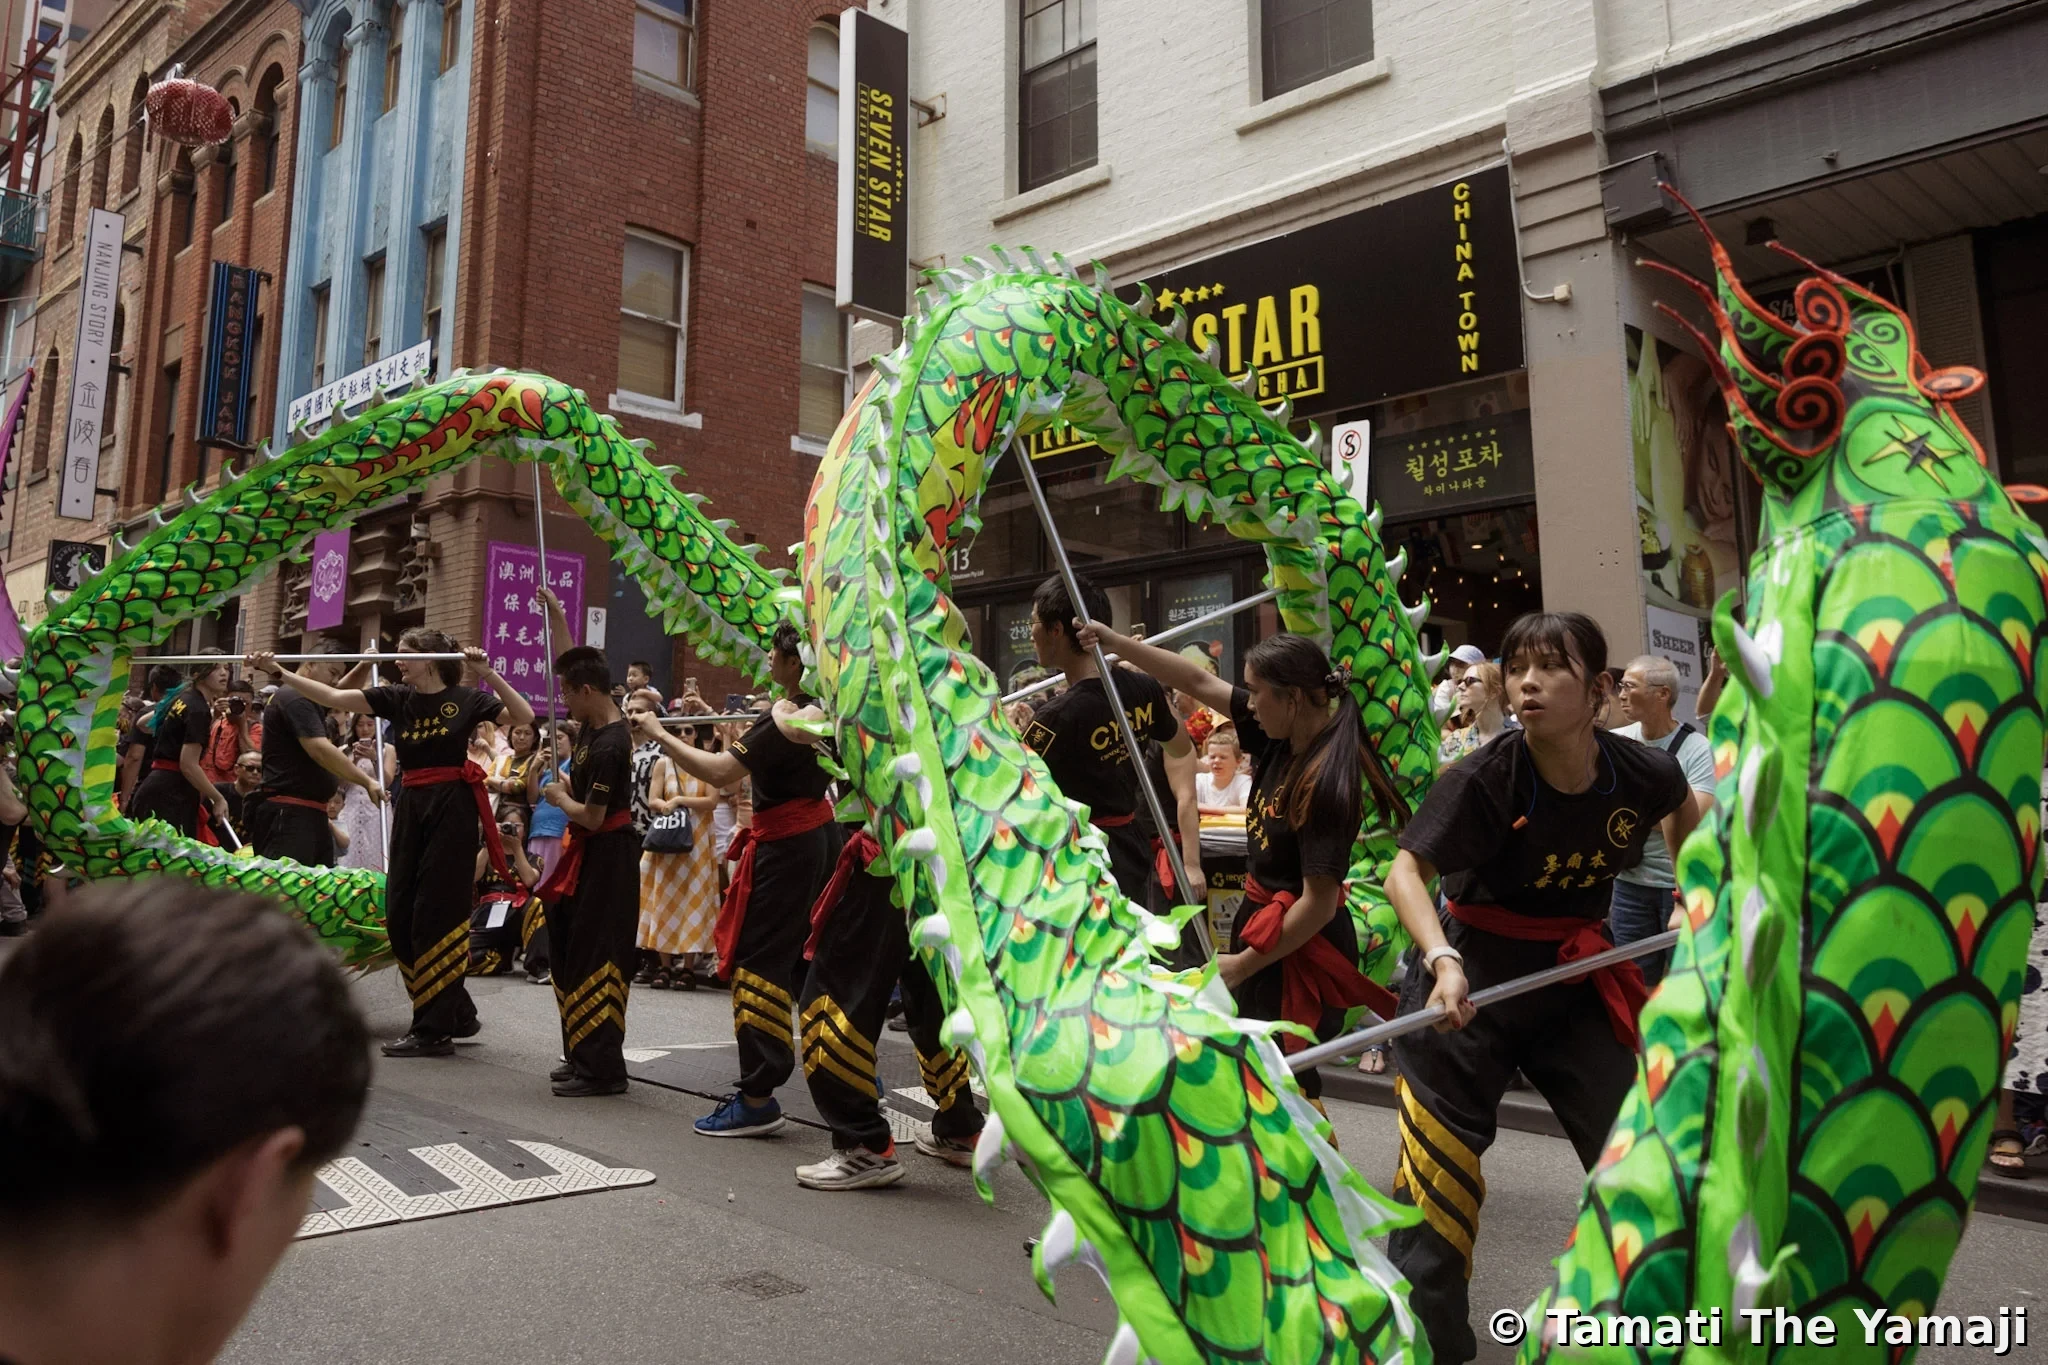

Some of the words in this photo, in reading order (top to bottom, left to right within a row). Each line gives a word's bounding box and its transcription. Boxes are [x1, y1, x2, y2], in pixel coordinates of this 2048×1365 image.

[859, 90, 868, 138] KOREAN
[869, 88, 893, 172] SEVEN
[858, 186, 867, 227] POCHA
[868, 176, 892, 242] STAR
[1452, 182, 1475, 283] CHINA
[91, 240, 114, 300] NANJING
[87, 302, 108, 347] STORY
[221, 272, 246, 380] BANGKOK
[1192, 284, 1321, 374] STAR
[1457, 290, 1480, 373] TOWN
[71, 380, 100, 484] 金陵春
[216, 391, 234, 437] JAM
[1404, 440, 1503, 482] 칠성포차
[951, 547, 970, 572] 13
[1652, 628, 1696, 656] SHEER
